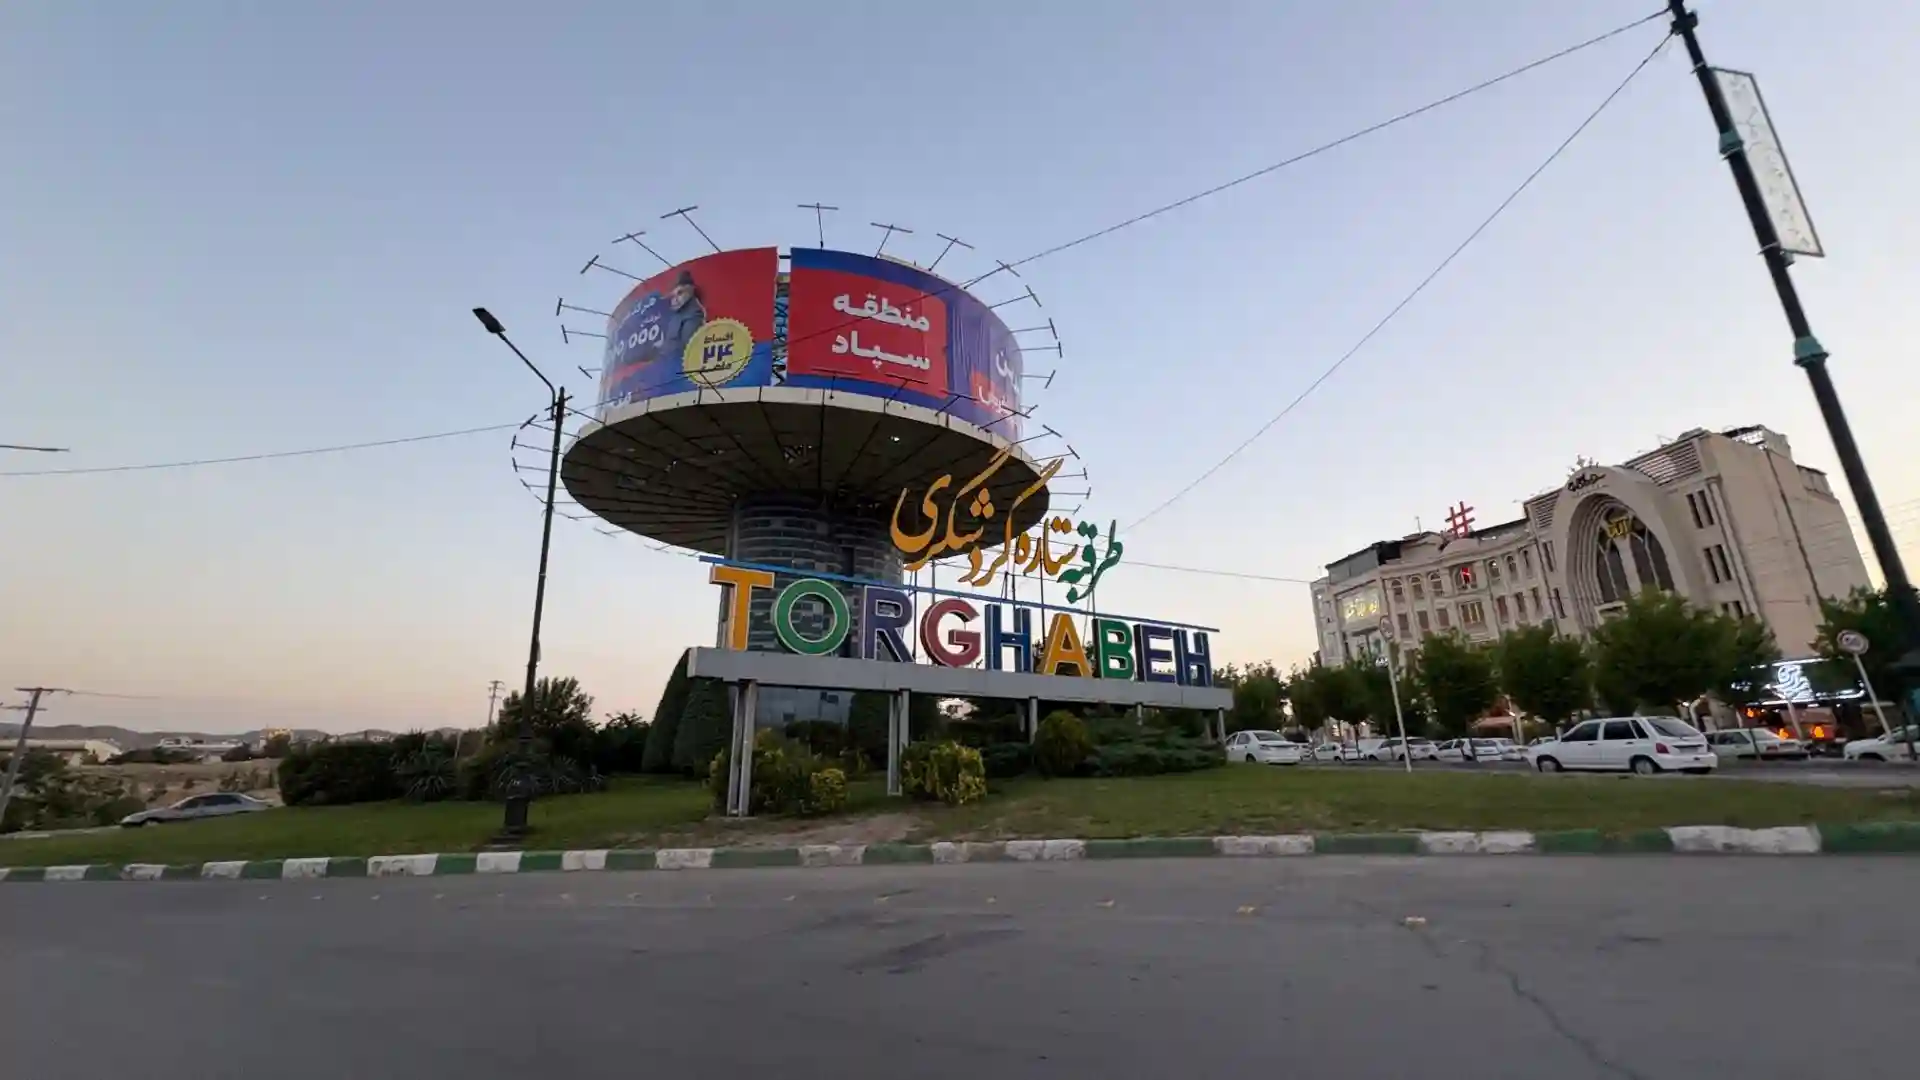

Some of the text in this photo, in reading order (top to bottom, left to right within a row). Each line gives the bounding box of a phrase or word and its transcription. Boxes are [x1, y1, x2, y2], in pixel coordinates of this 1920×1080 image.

[832, 292, 930, 332] منطقه
[702, 343, 735, 364] ۲۴
[831, 329, 931, 370] سپاد
[890, 444, 1124, 604] طرقبه ستاره گردشگری
[708, 563, 1213, 687] TORGHABEH
